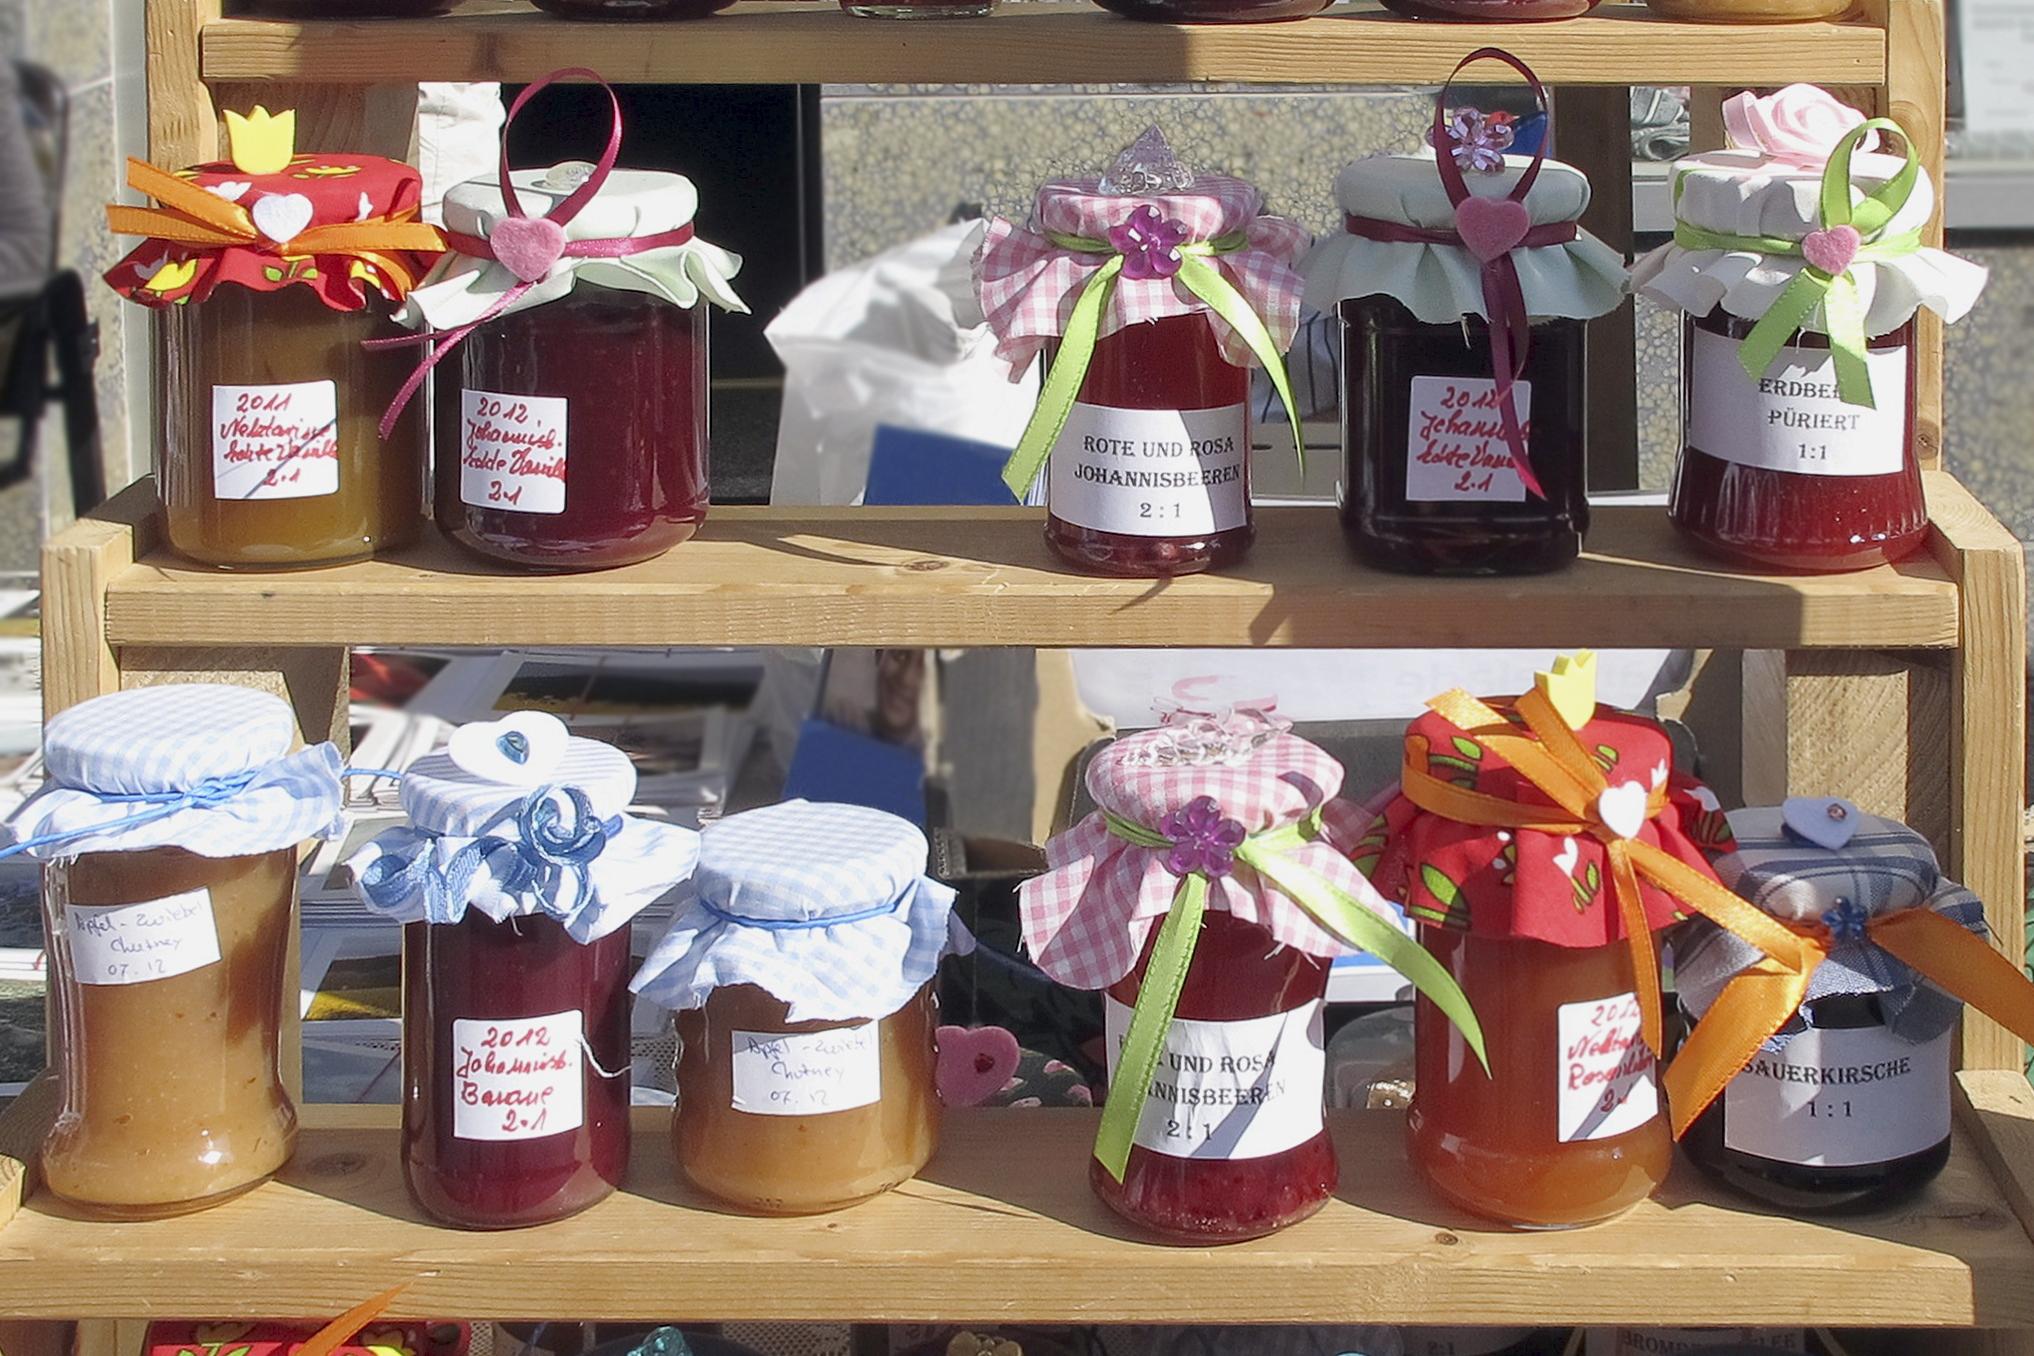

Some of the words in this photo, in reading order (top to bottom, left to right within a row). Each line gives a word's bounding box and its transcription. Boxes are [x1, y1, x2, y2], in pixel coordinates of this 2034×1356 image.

[236, 393, 292, 413] 2011
[477, 396, 529, 424] 2012
[1768, 407, 1860, 430] PÜRIERT
[1084, 435, 1136, 457] ROTE
[1143, 442, 1183, 457] UND
[1190, 436, 1234, 457] ROSA
[1074, 463, 1241, 488] JOHANNISBEEREN
[481, 1026, 551, 1048] 2012
[1169, 1056, 1213, 1073] UND
[1220, 1050, 1275, 1073] ROSA
